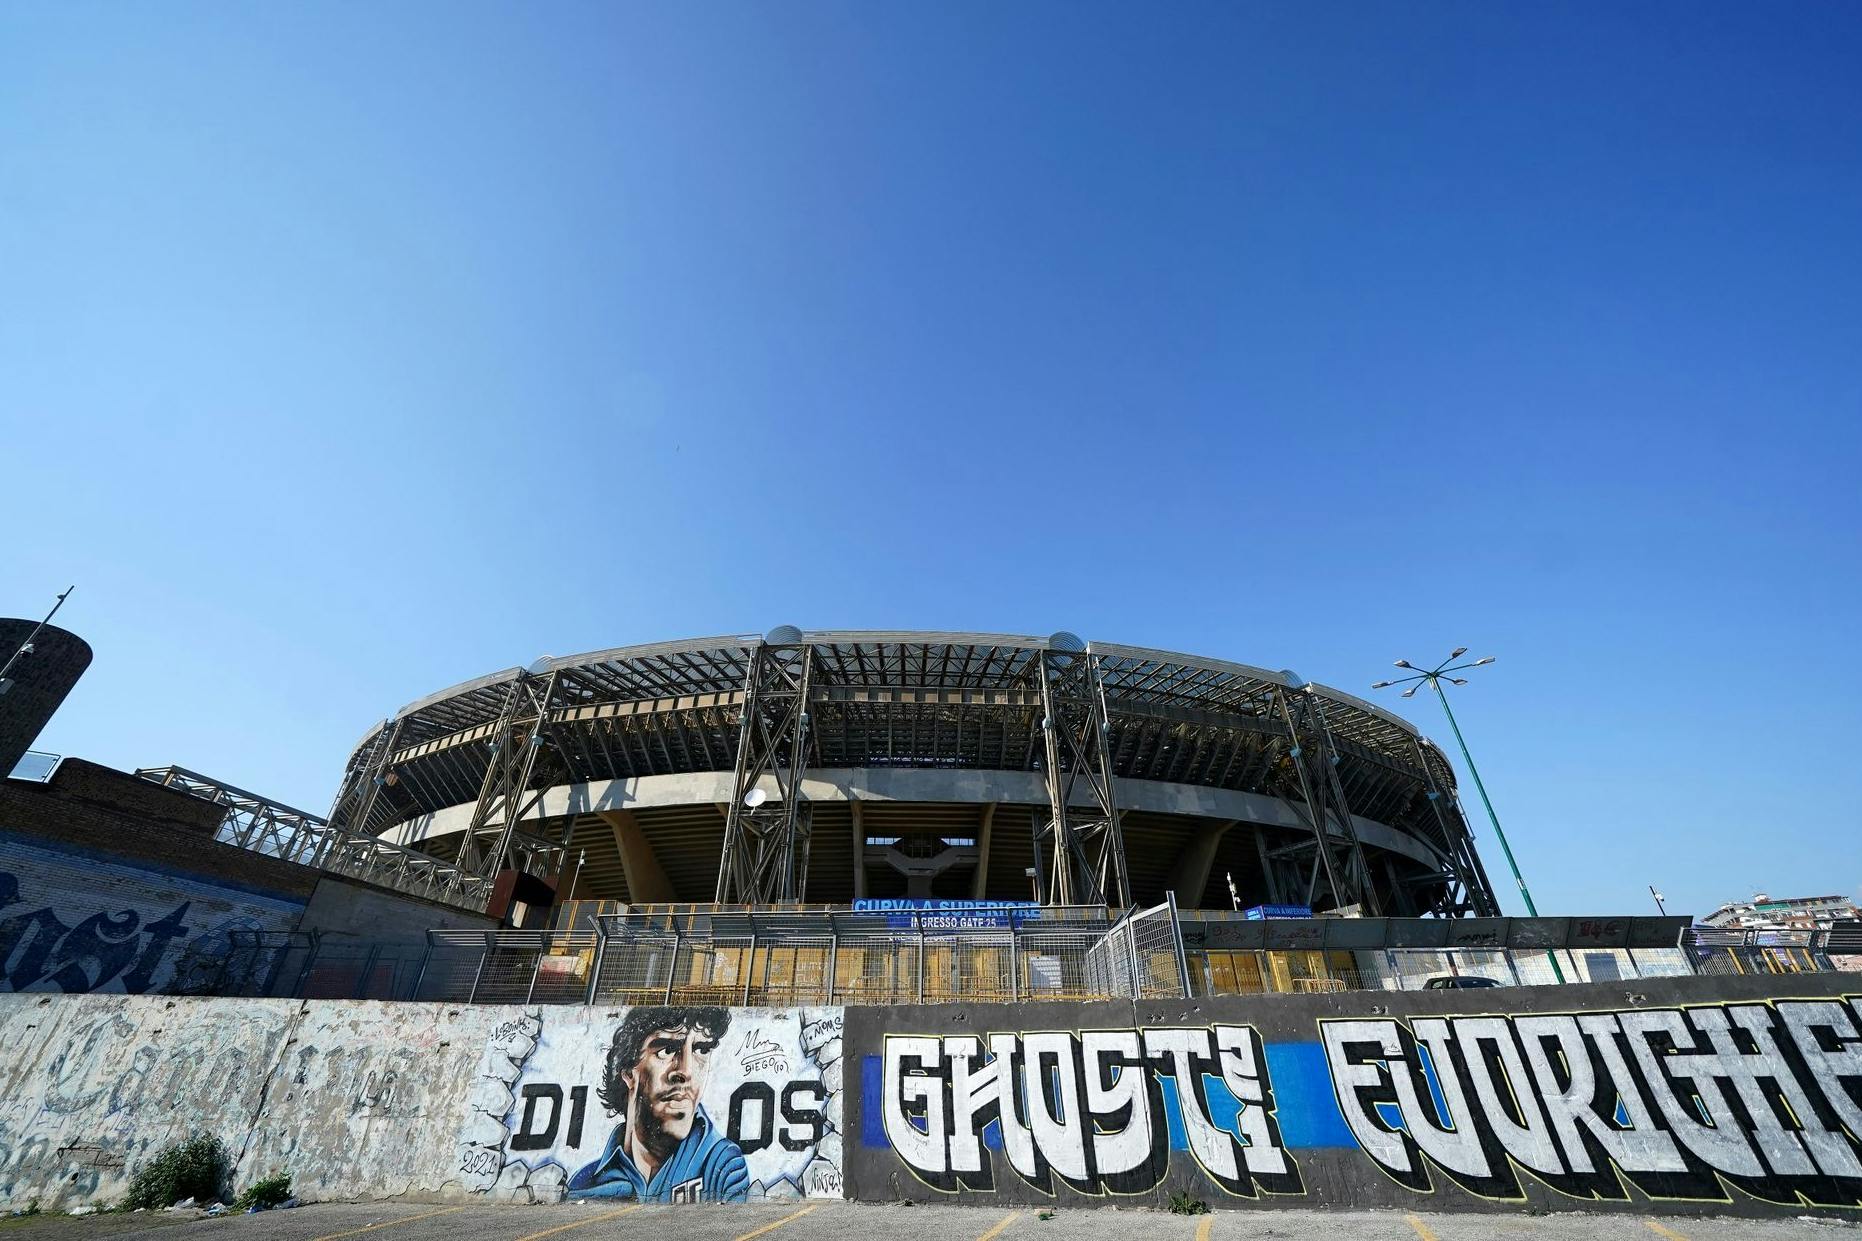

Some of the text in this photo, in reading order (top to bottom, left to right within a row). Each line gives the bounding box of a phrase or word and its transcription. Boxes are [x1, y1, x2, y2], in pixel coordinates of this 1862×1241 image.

[855, 900, 1041, 917] CURVA A SUPERIORE
[910, 917, 957, 928] INGRESSO
[960, 917, 984, 928] GATE
[460, 1150, 496, 1176] 2021
